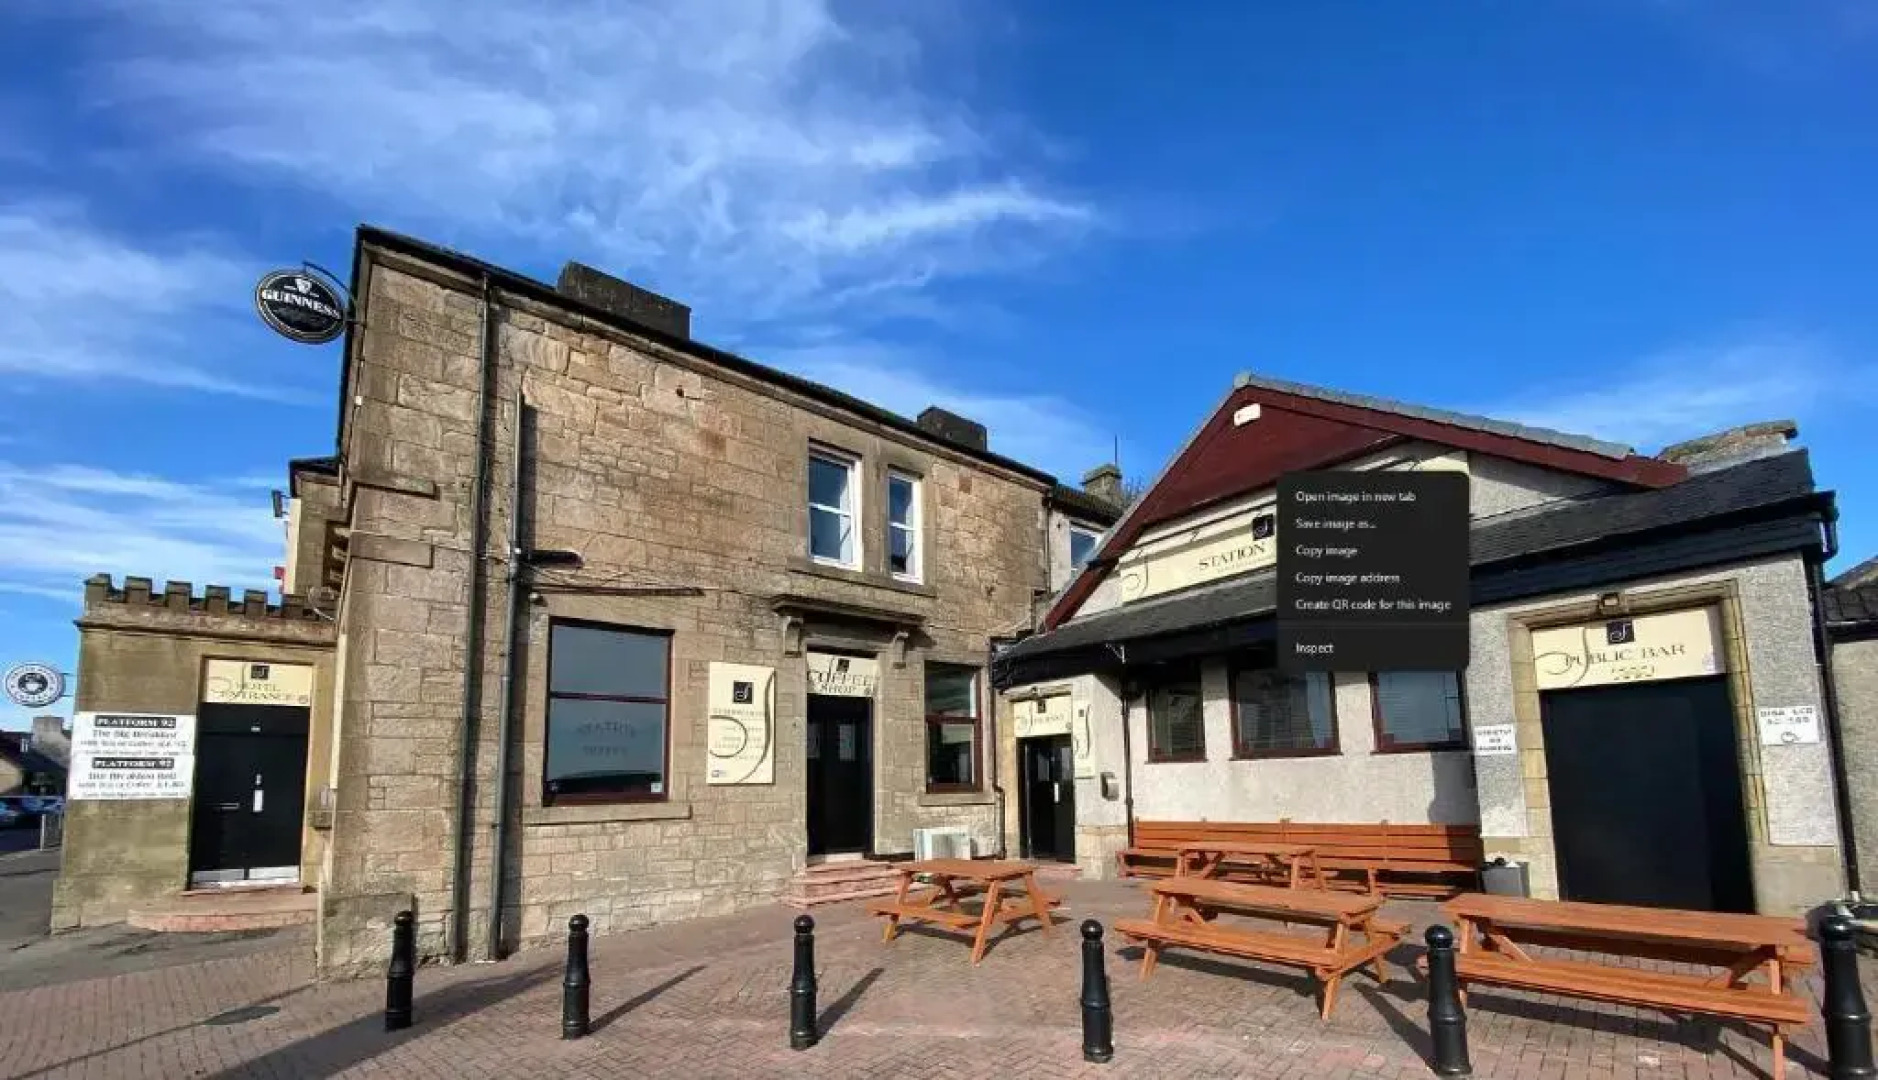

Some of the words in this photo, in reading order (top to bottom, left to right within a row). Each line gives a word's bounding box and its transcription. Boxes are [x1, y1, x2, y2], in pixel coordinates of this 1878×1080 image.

[261, 289, 341, 319] GUINNESS
[1199, 541, 1265, 570] STATION
[1565, 649, 1632, 666] PUBLIC
[1642, 645, 1686, 658] BAR
[97, 717, 157, 727] PLATFORM
